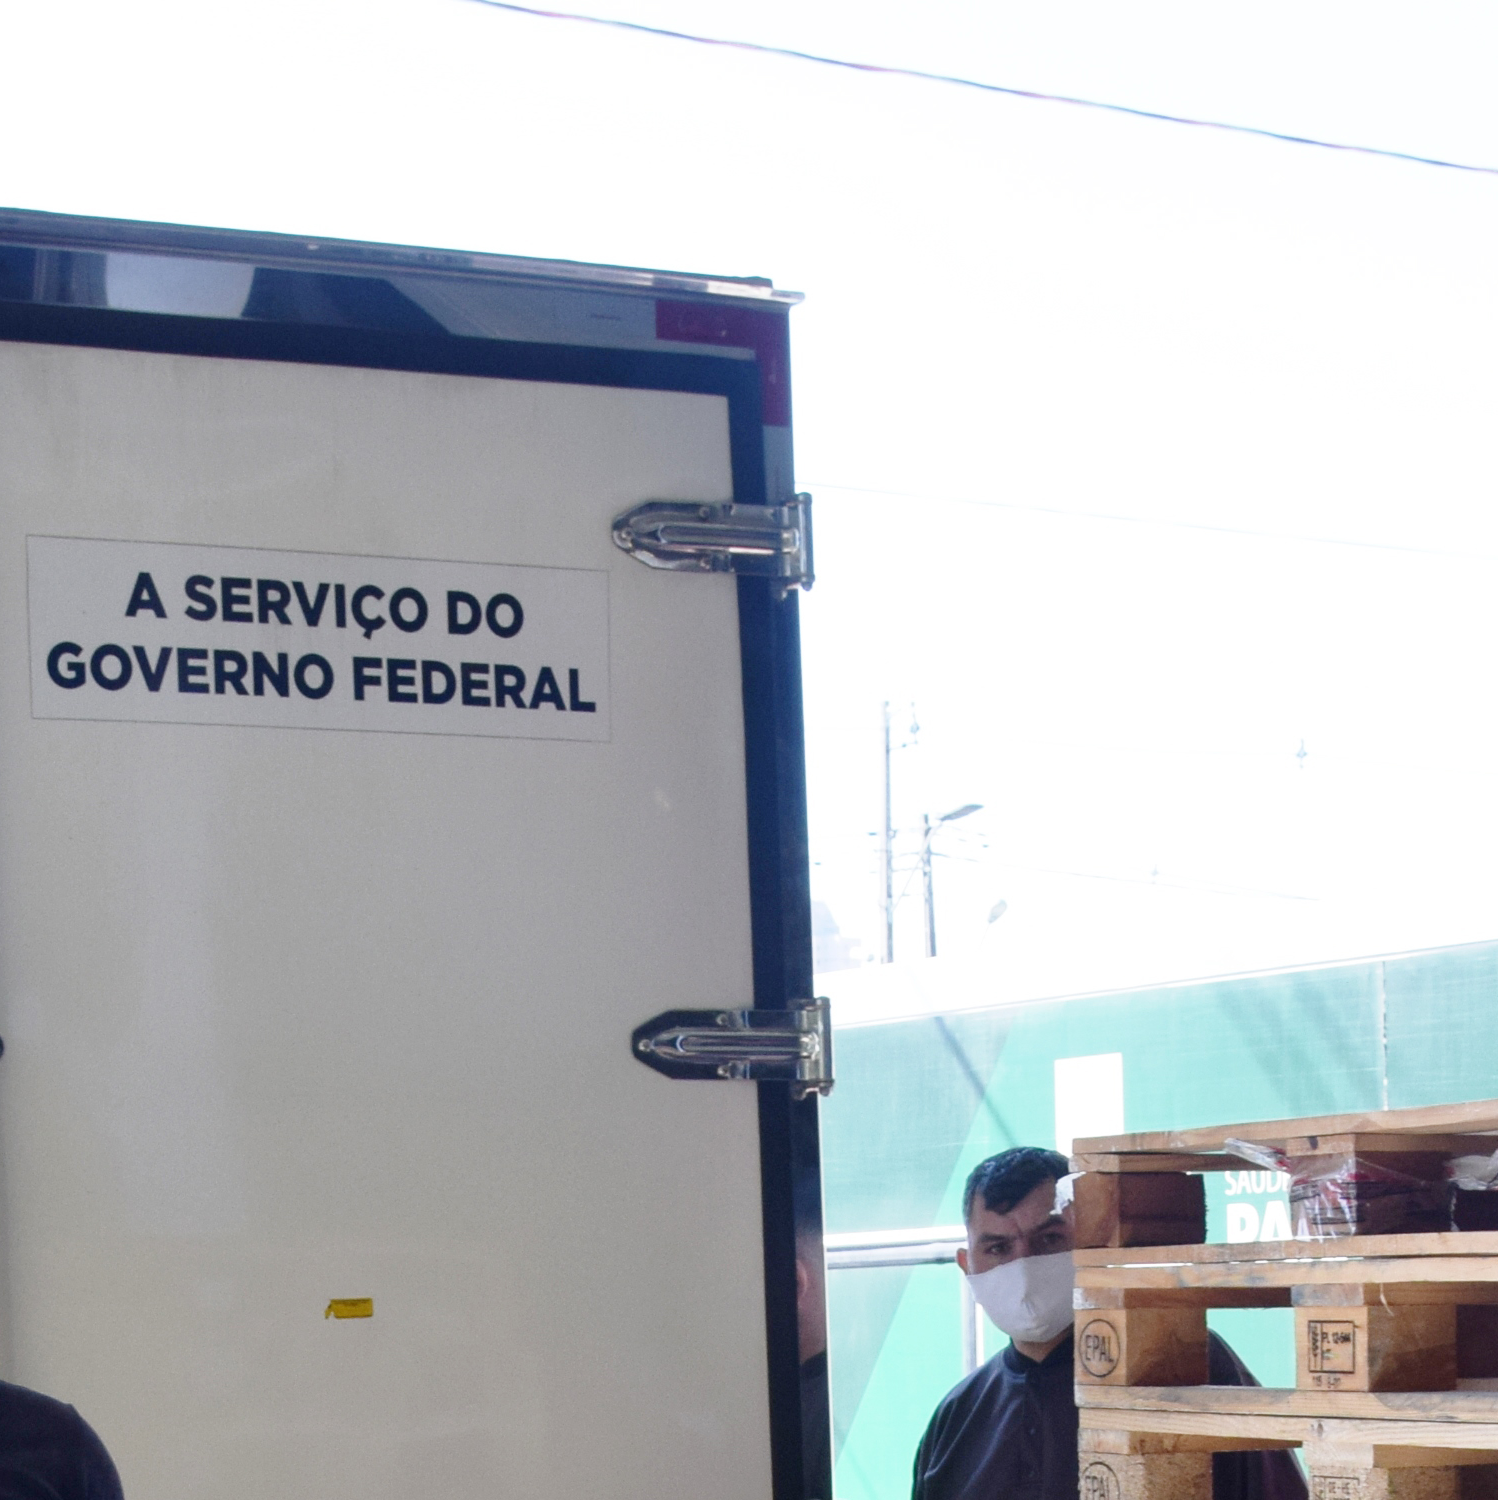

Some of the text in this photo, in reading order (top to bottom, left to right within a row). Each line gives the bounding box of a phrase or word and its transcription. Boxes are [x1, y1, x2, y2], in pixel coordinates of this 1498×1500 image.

[125, 572, 525, 639] A SERVIÇO DO
[47, 641, 597, 713] GOVERNO FEDERAL
[1085, 1334, 1114, 1363] EPAL
